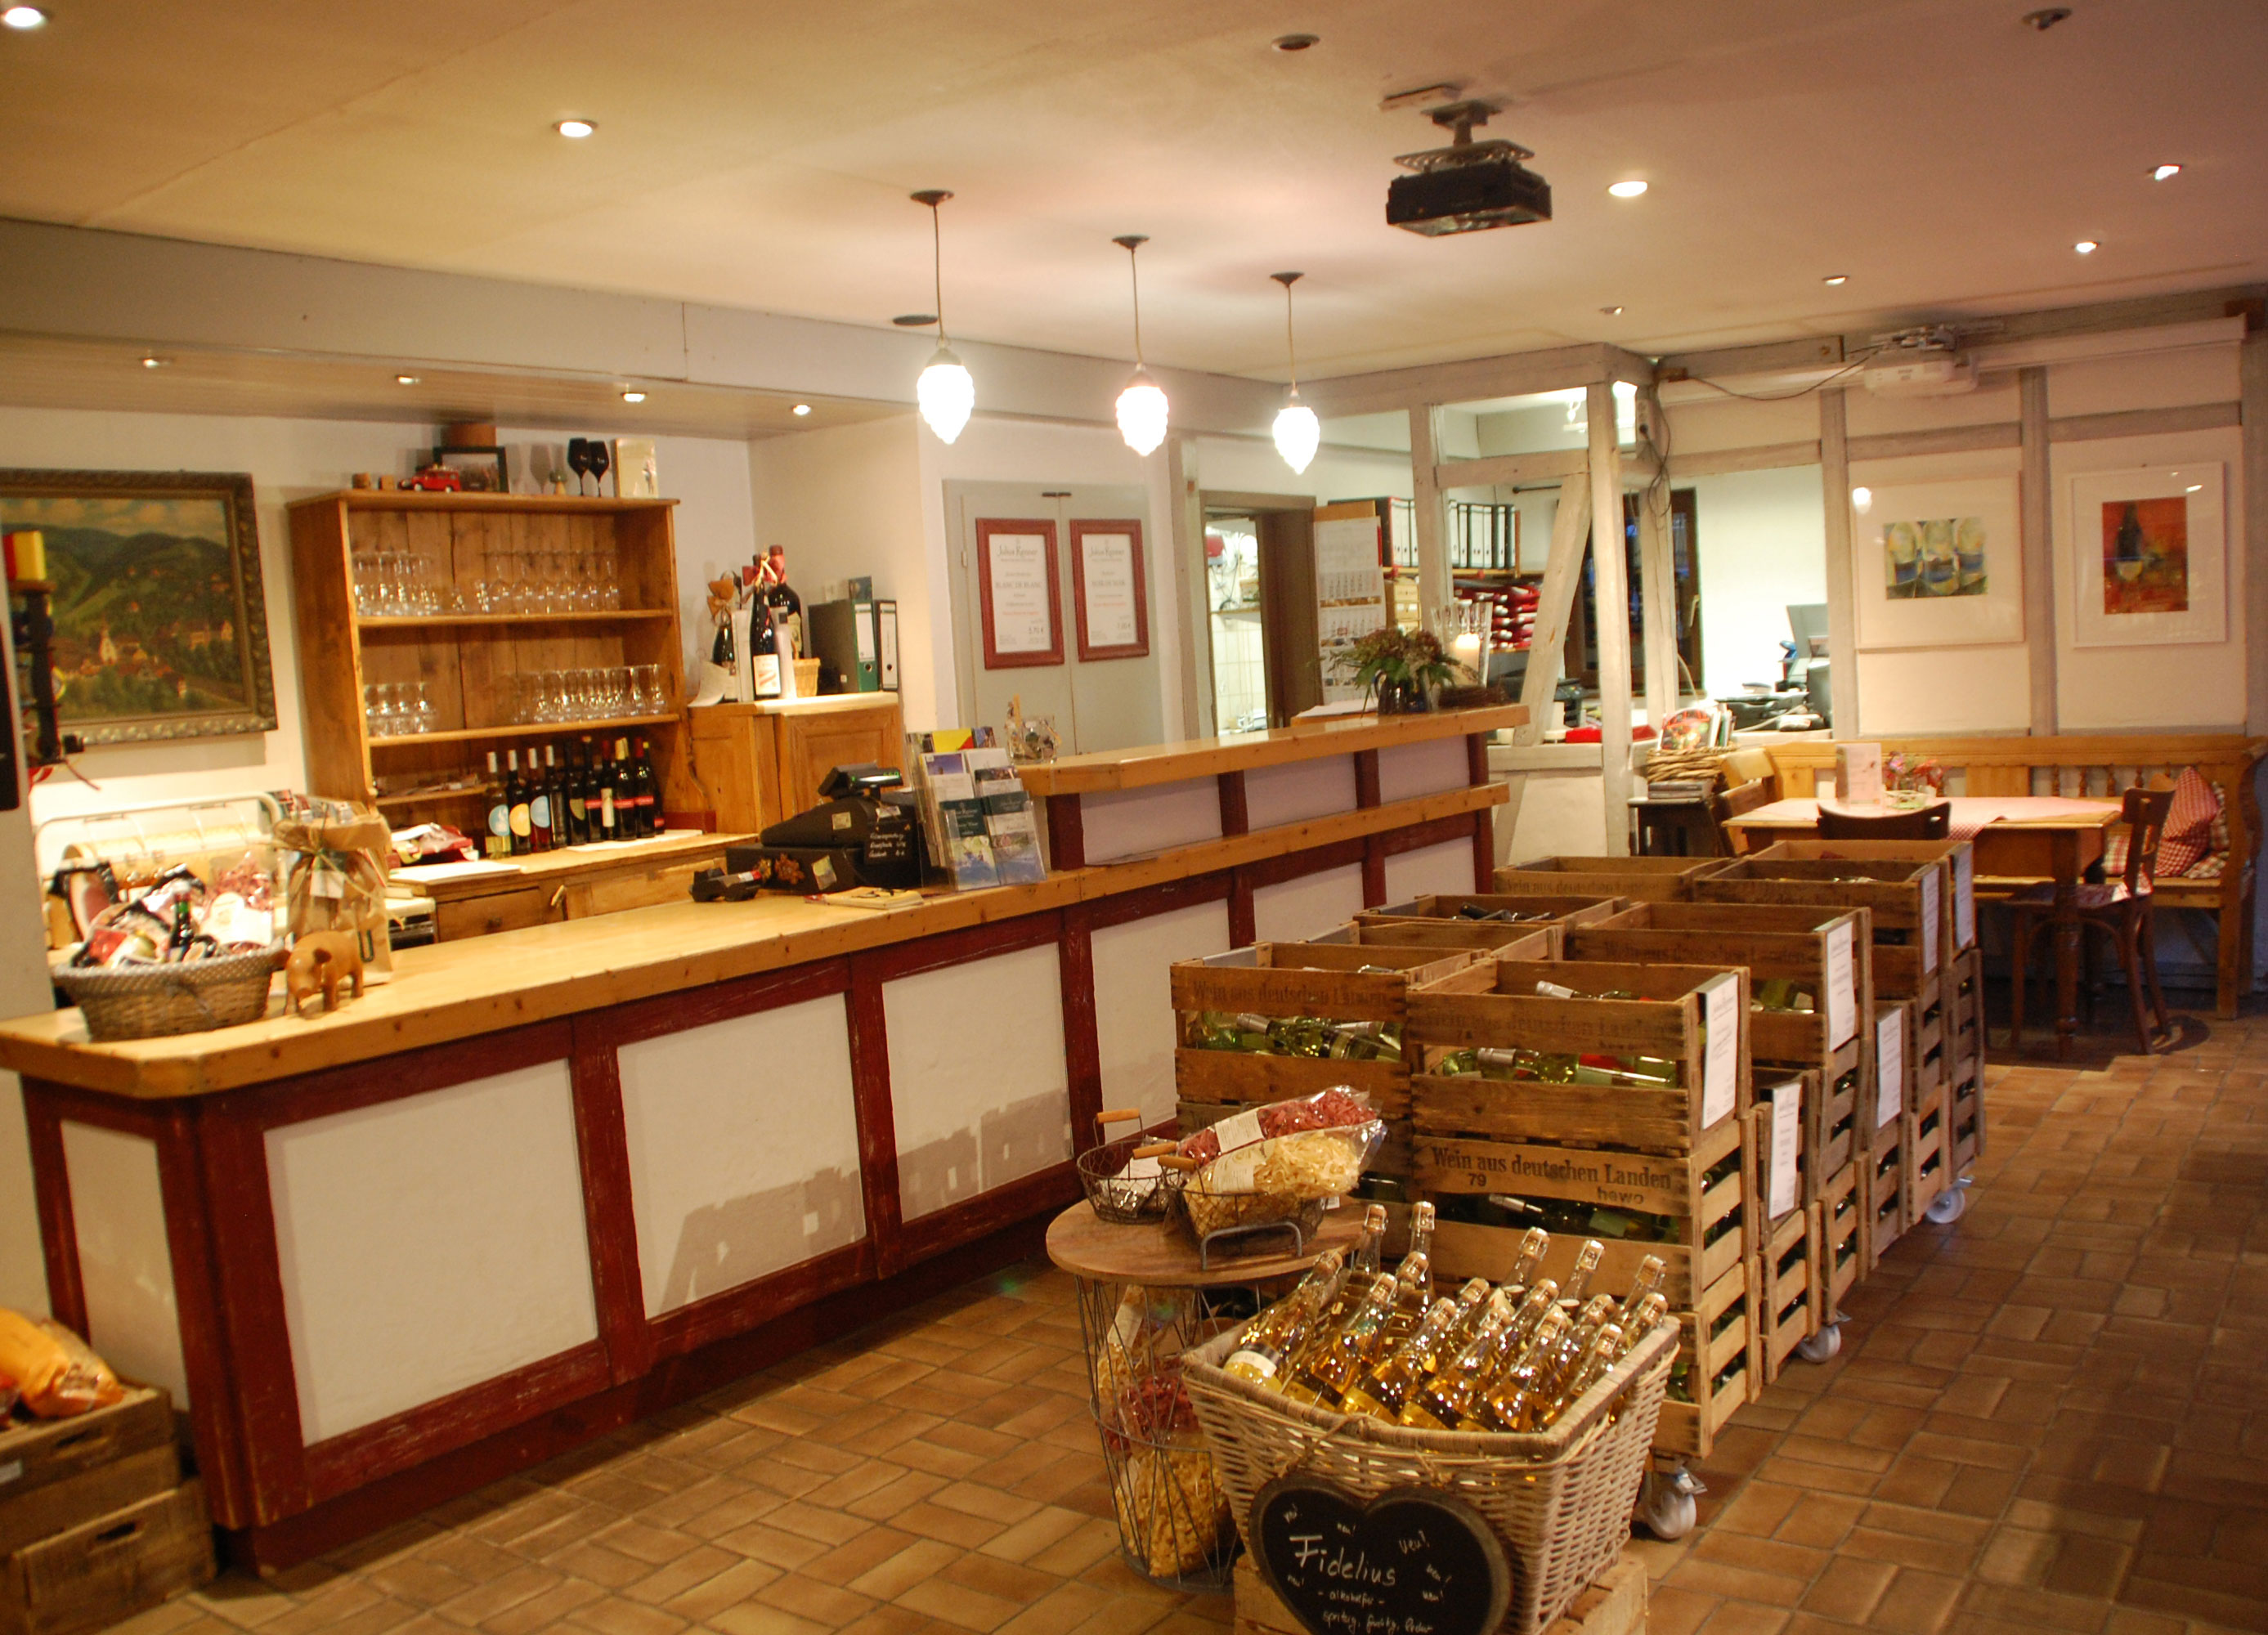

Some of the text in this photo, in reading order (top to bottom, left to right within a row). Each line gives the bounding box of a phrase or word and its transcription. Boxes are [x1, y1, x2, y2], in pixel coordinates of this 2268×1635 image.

[1431, 1146, 1673, 1189] Wein aus deutschen Landen
[1468, 1172, 1488, 1188] 79
[1289, 1534, 1396, 1587] Fidelius
